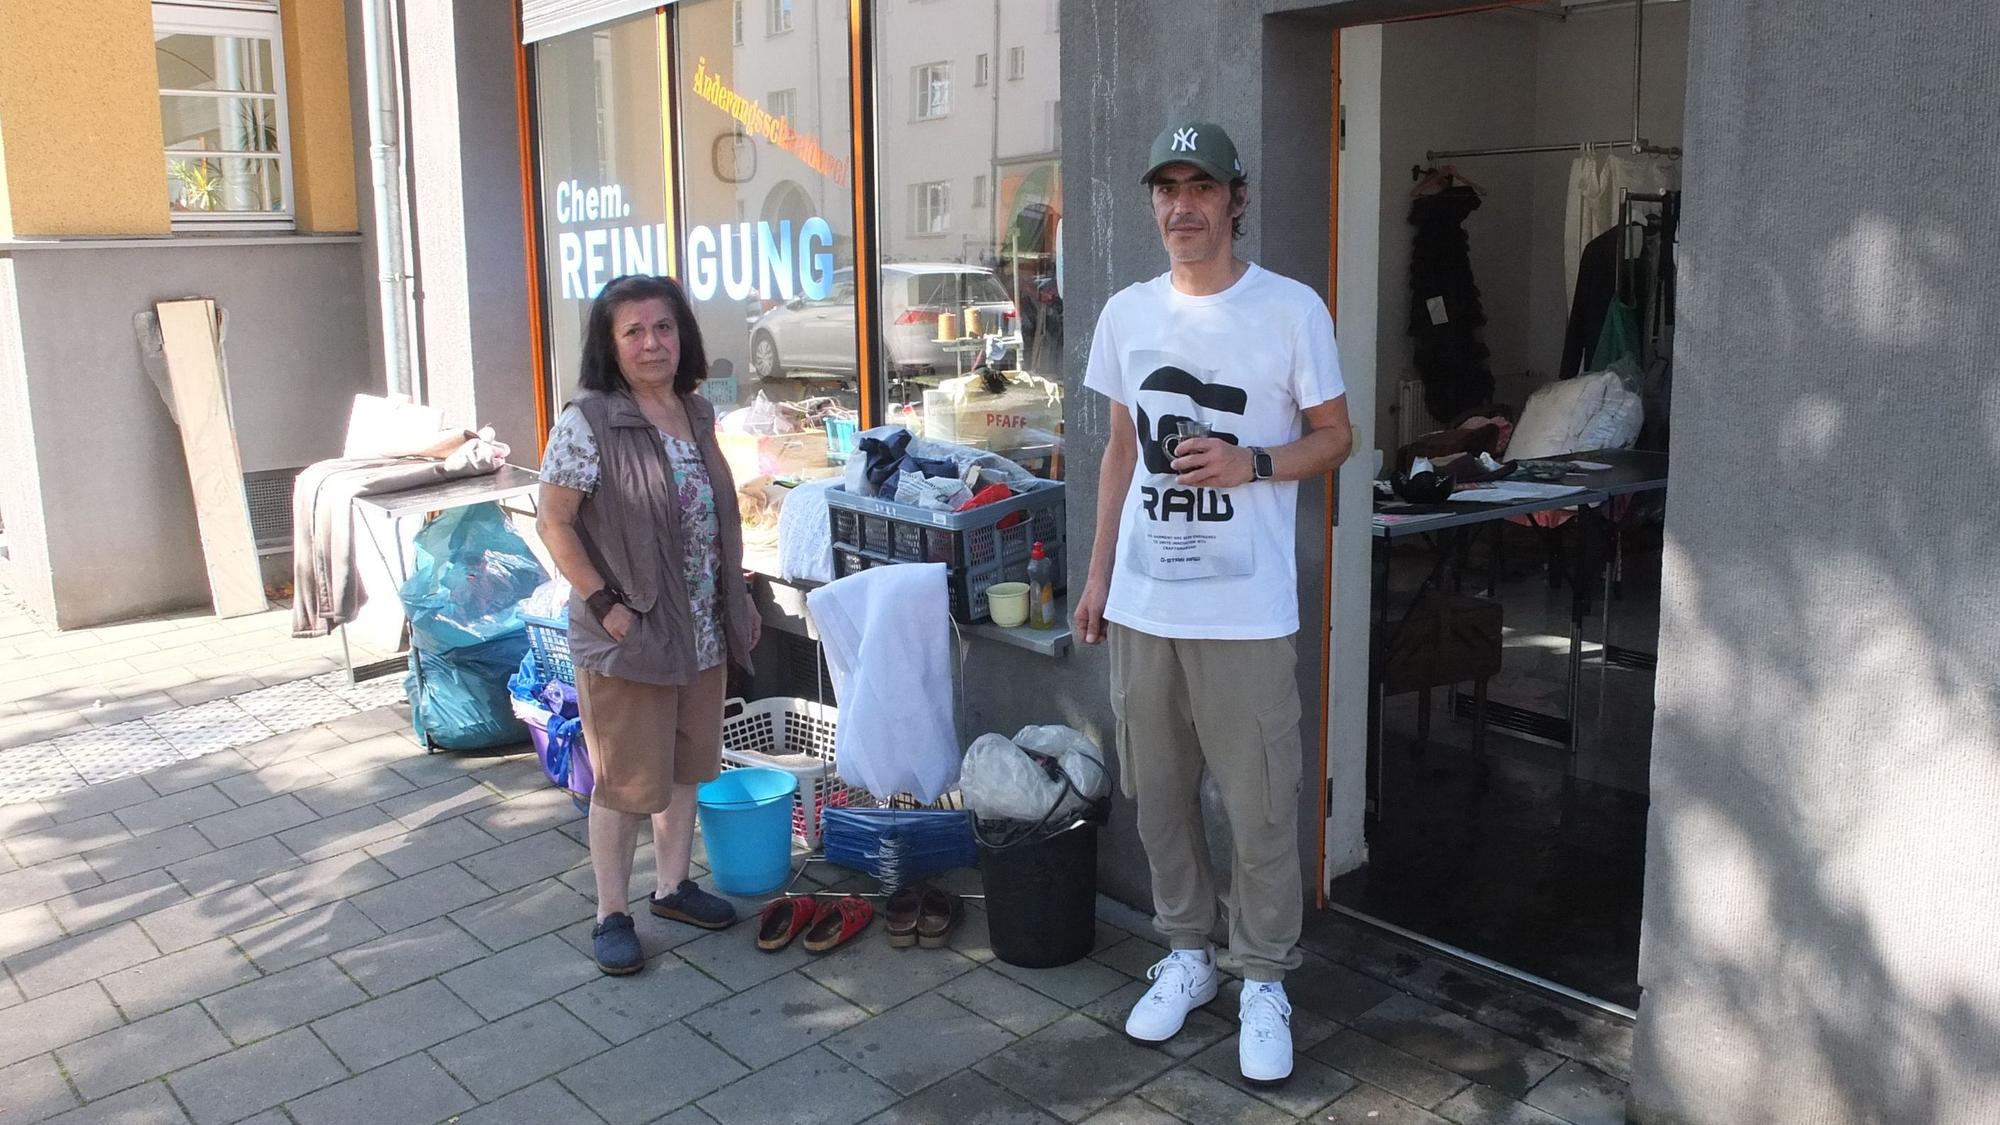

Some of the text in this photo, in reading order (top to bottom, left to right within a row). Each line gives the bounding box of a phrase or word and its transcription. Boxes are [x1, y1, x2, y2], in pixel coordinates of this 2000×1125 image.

[1171, 127, 1198, 151] NY
[556, 179, 630, 223] Chem.
[986, 413, 1027, 429] PFAFF
[1141, 486, 1234, 522] RAW
